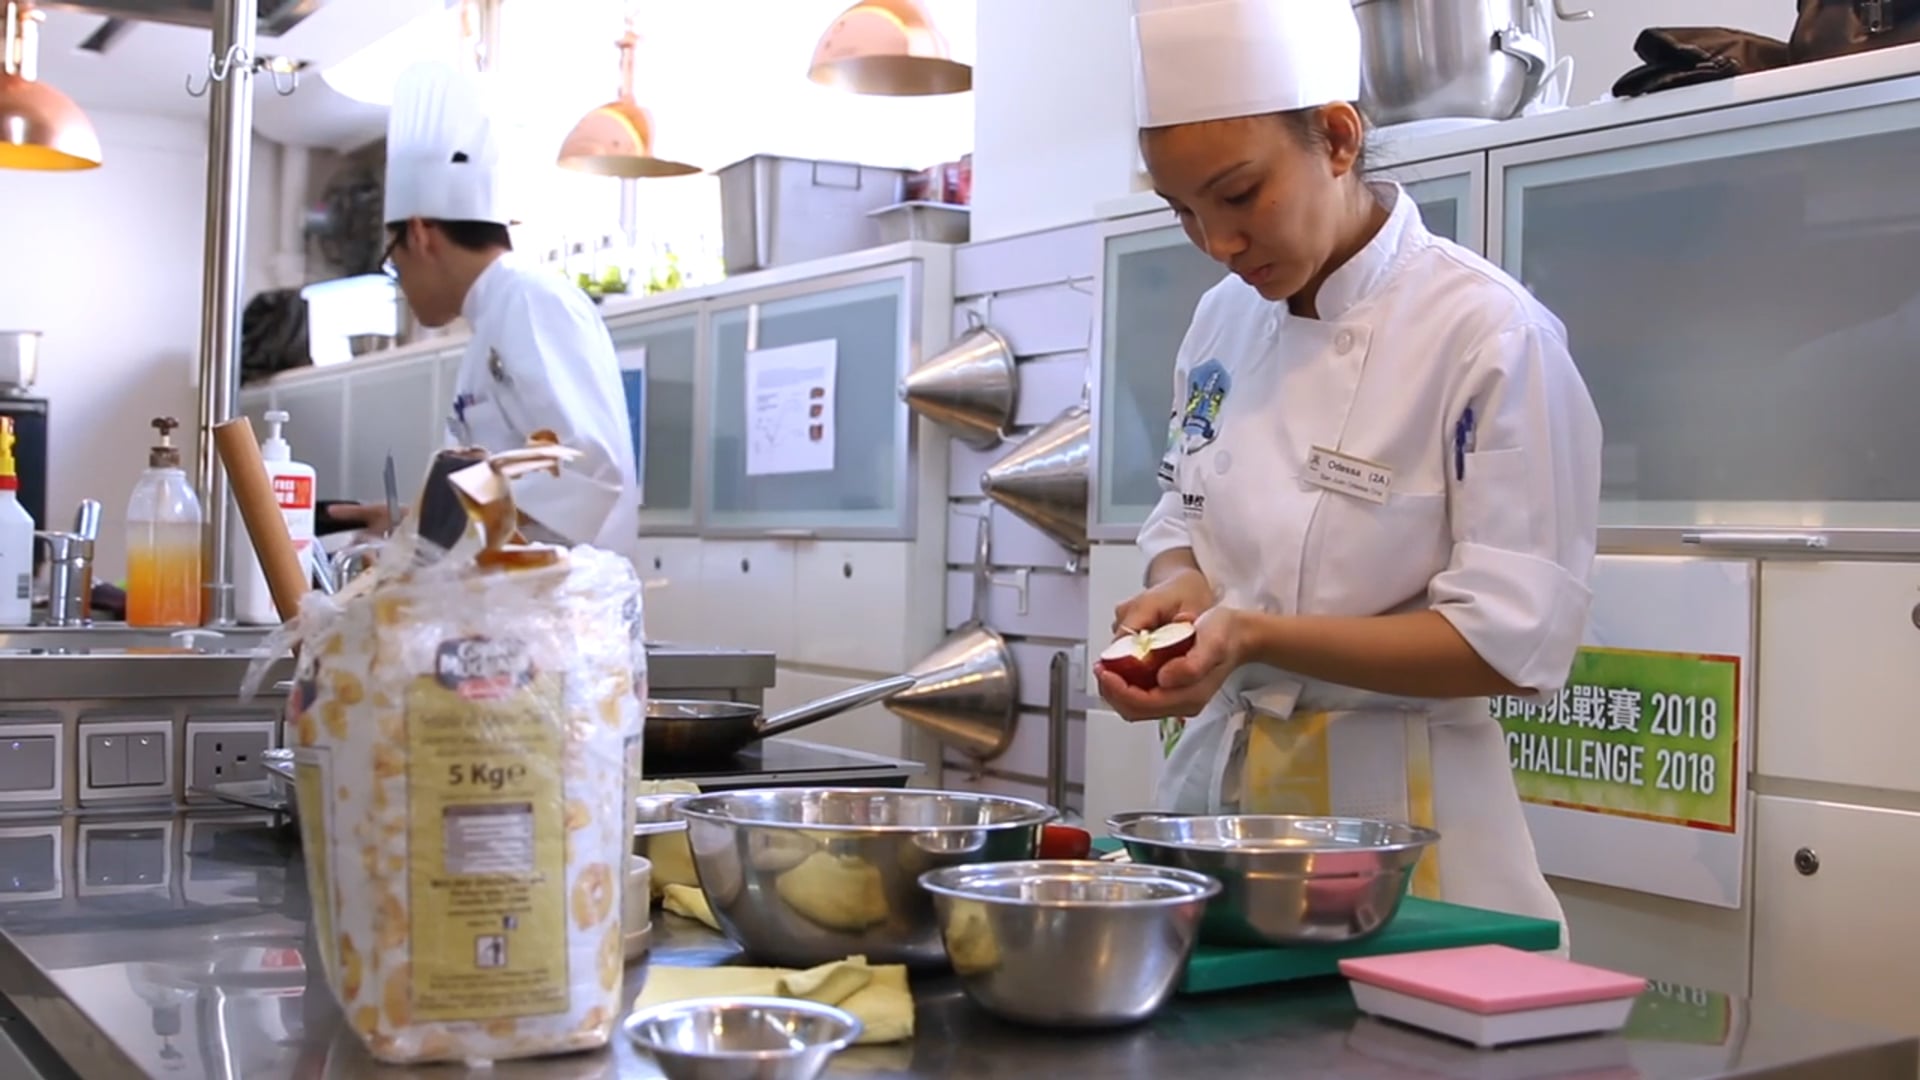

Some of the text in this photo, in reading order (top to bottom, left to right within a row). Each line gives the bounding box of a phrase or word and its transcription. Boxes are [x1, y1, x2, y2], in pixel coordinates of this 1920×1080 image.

[1328, 460, 1361, 477] Odessa
[1650, 692, 1717, 740] 2018
[448, 763, 464, 786] 5
[1506, 731, 1715, 795] CHALLENGE 2018
